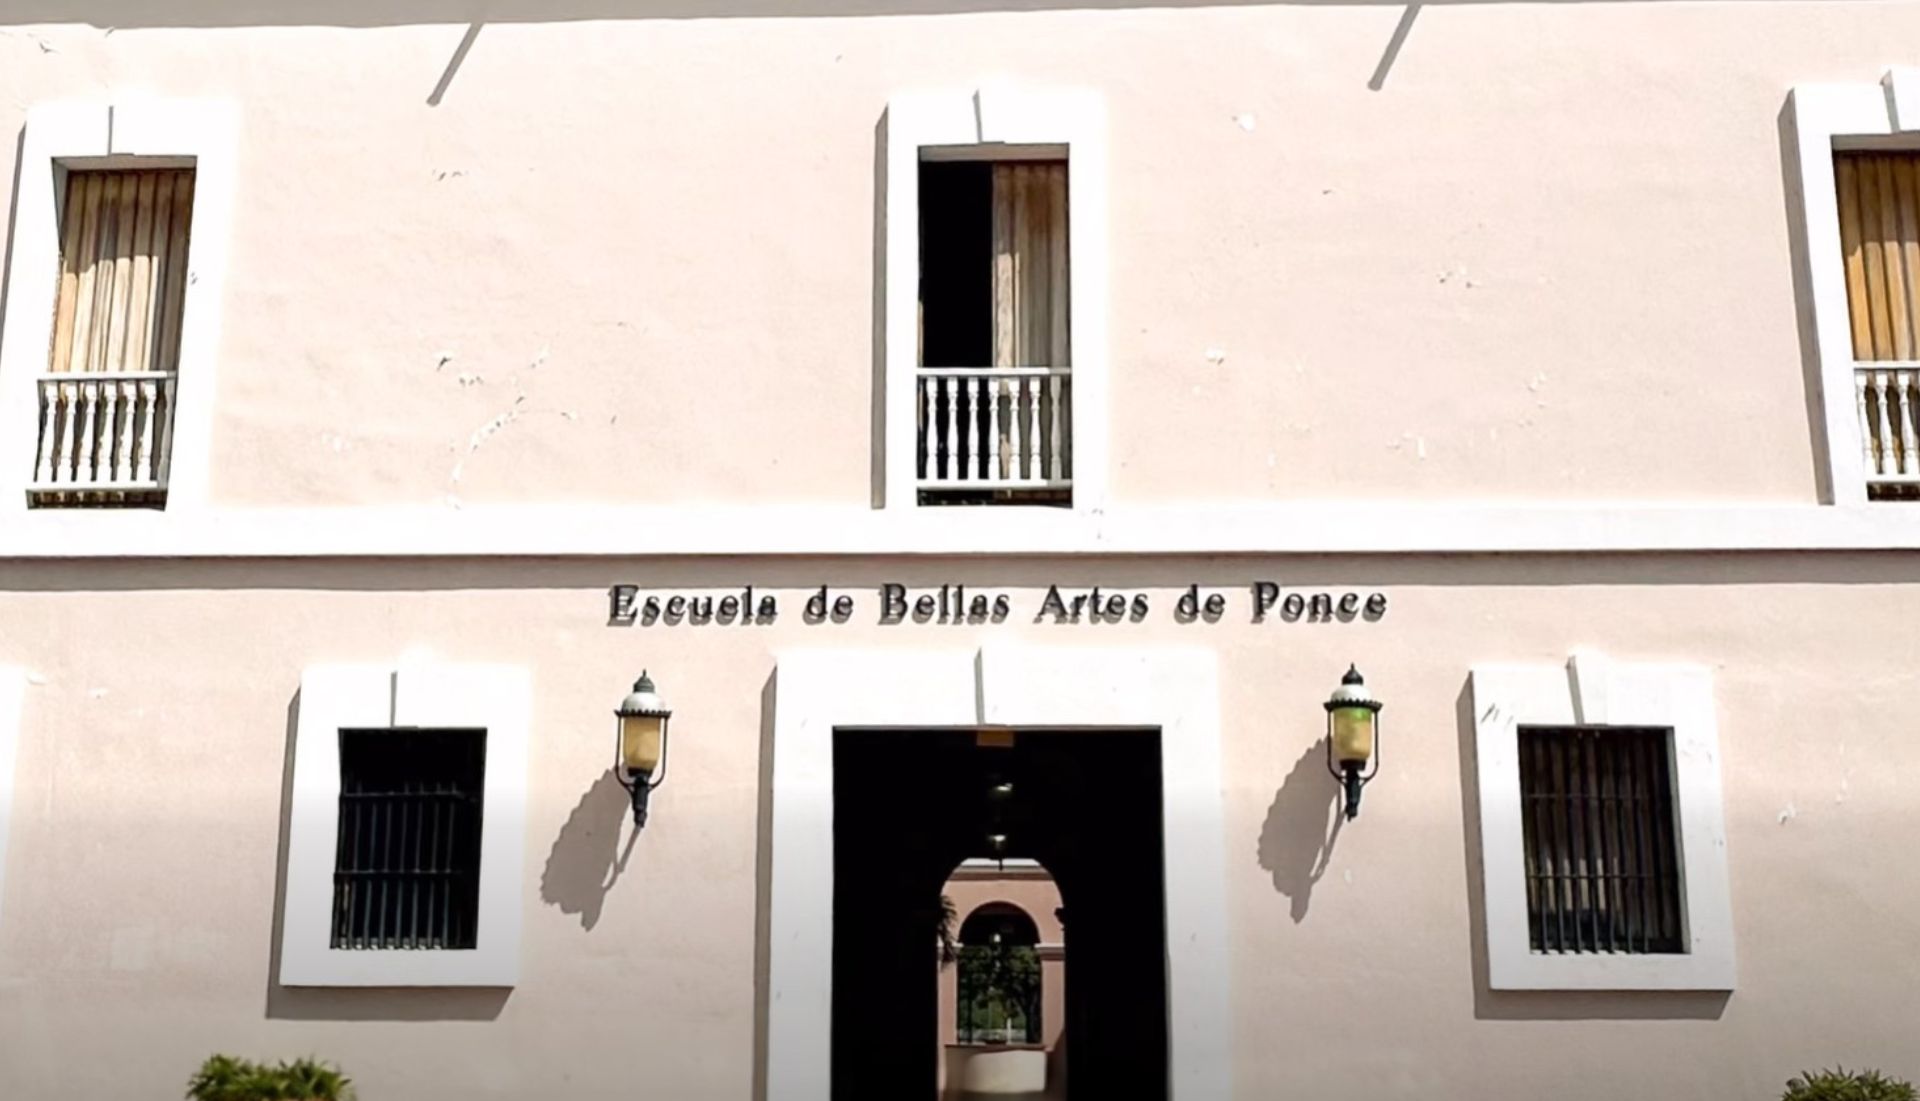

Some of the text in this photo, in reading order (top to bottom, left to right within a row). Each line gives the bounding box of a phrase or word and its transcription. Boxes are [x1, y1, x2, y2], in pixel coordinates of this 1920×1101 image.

[611, 581, 1387, 620] Escuela de Bellas Artes de Ponce
